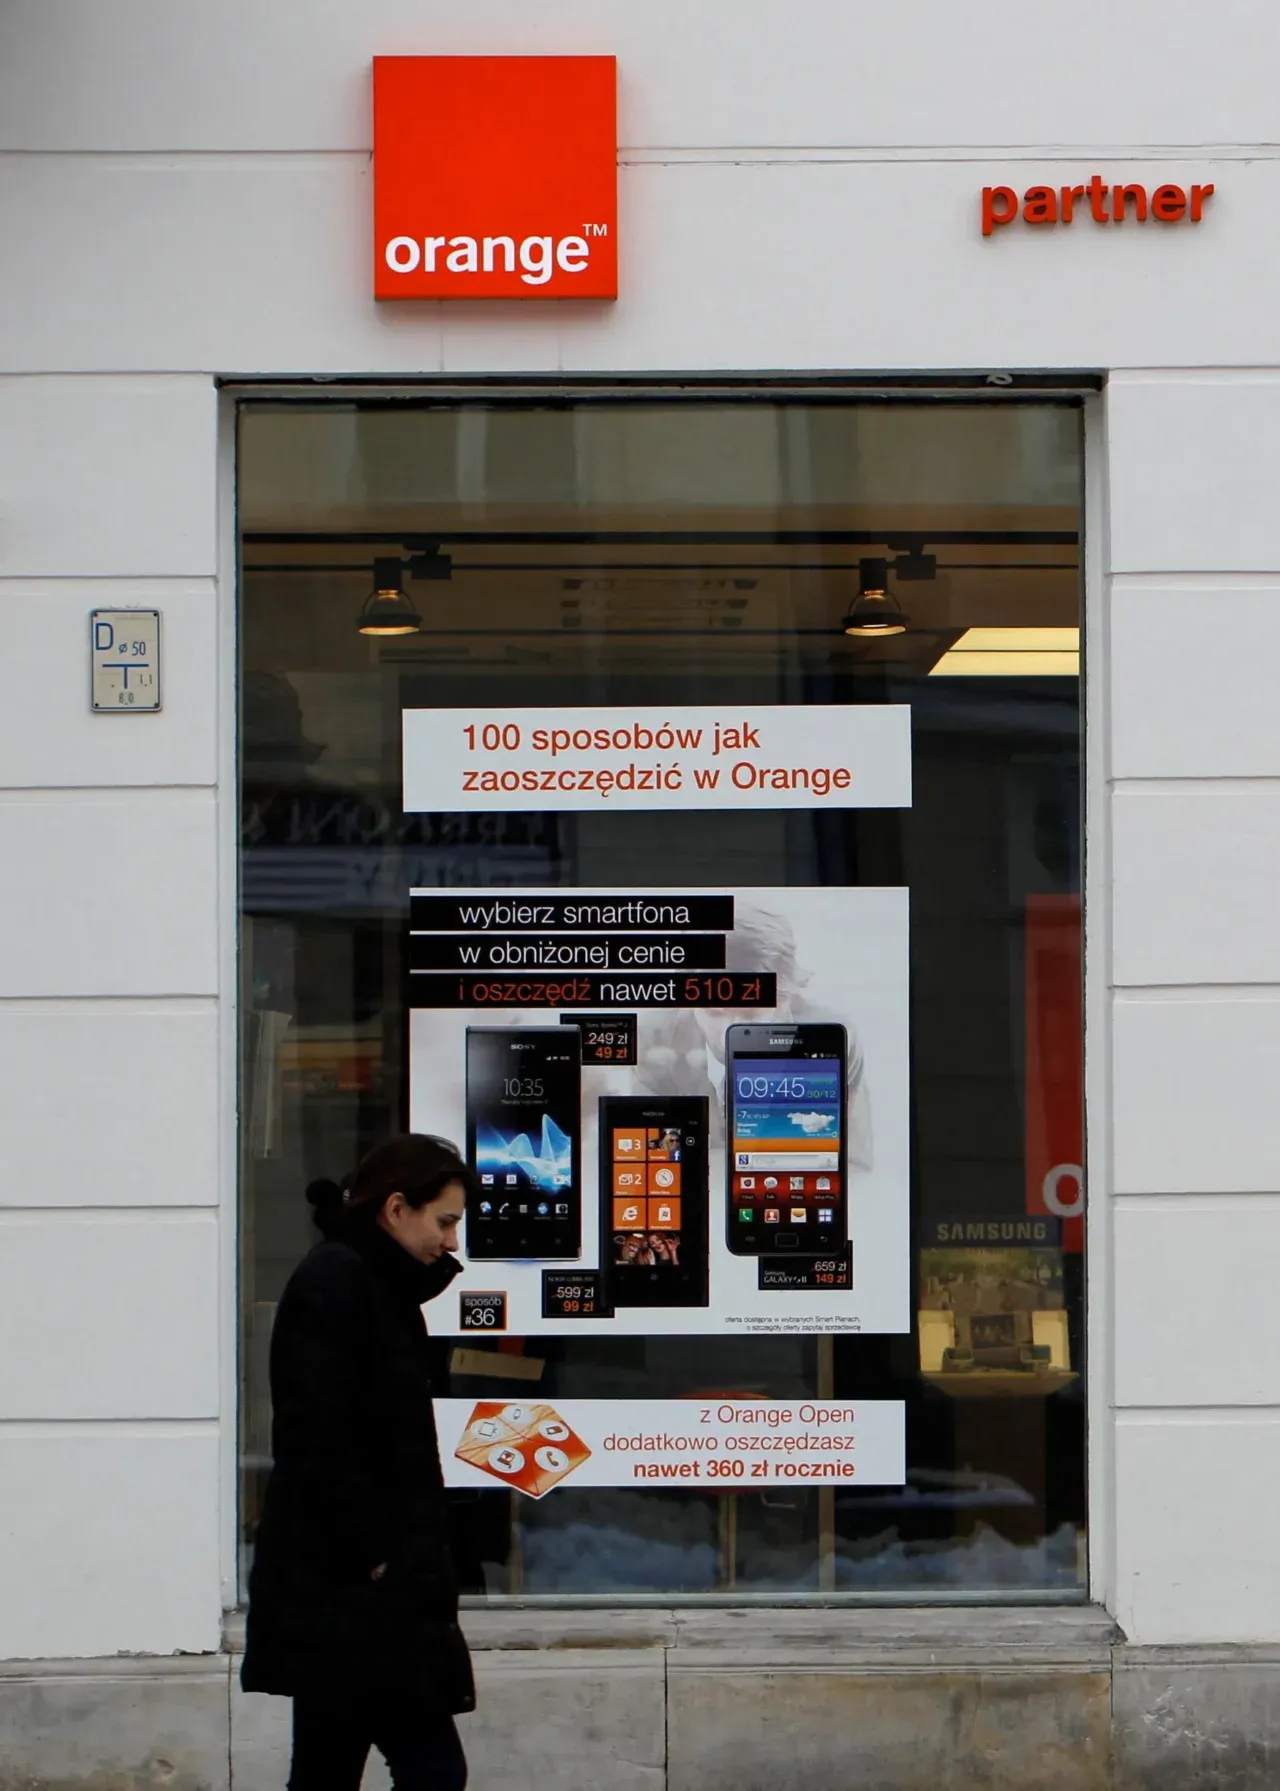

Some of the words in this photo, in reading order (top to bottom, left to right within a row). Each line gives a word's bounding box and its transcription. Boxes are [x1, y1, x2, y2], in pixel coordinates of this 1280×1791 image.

[981, 175, 1215, 236] partner
[385, 231, 590, 285] orange
[95, 622, 114, 651] D
[132, 641, 146, 656] 50
[462, 724, 521, 750] 100
[531, 722, 703, 756] sposobów
[712, 721, 761, 755] jak
[461, 763, 683, 798] zaoszczędzić
[693, 769, 721, 789] w
[730, 761, 852, 795] Orange
[458, 902, 555, 928] wybierz
[562, 901, 690, 924] smartfona
[458, 944, 482, 964] w
[488, 939, 609, 969] obniżonej
[618, 941, 685, 964] cenie
[458, 978, 464, 1000] i
[472, 977, 591, 1008] oszczędź
[599, 979, 677, 1001] nawet
[684, 977, 733, 1001] 510
[740, 977, 762, 1001] zł
[588, 1032, 614, 1045] 249
[617, 1032, 628, 1045] zł
[594, 1046, 612, 1058] 49
[616, 1046, 628, 1059] zł
[503, 1078, 545, 1097] 10:35
[738, 1076, 805, 1098] 09:45
[634, 1139, 642, 1151] 3
[634, 1173, 642, 1185] 2
[937, 1222, 1047, 1241] SAMSUNG
[814, 1261, 836, 1272] 659
[837, 1261, 847, 1271] zł
[815, 1273, 834, 1283] 149
[837, 1273, 846, 1283] zł
[464, 1296, 502, 1307] sposób
[556, 1286, 581, 1298] 599
[584, 1286, 595, 1298] zł
[563, 1300, 580, 1312] 99
[583, 1300, 595, 1312] zł
[464, 1308, 495, 1326] #36
[700, 1408, 711, 1423] z
[717, 1404, 792, 1427] Orange
[799, 1404, 855, 1427] Open
[603, 1434, 718, 1452] dodatkowo
[724, 1433, 855, 1455] oszczędzasz
[633, 1461, 701, 1478] nawet
[706, 1460, 745, 1478] 360
[750, 1460, 769, 1478] zł
[774, 1460, 855, 1478] rocznie
